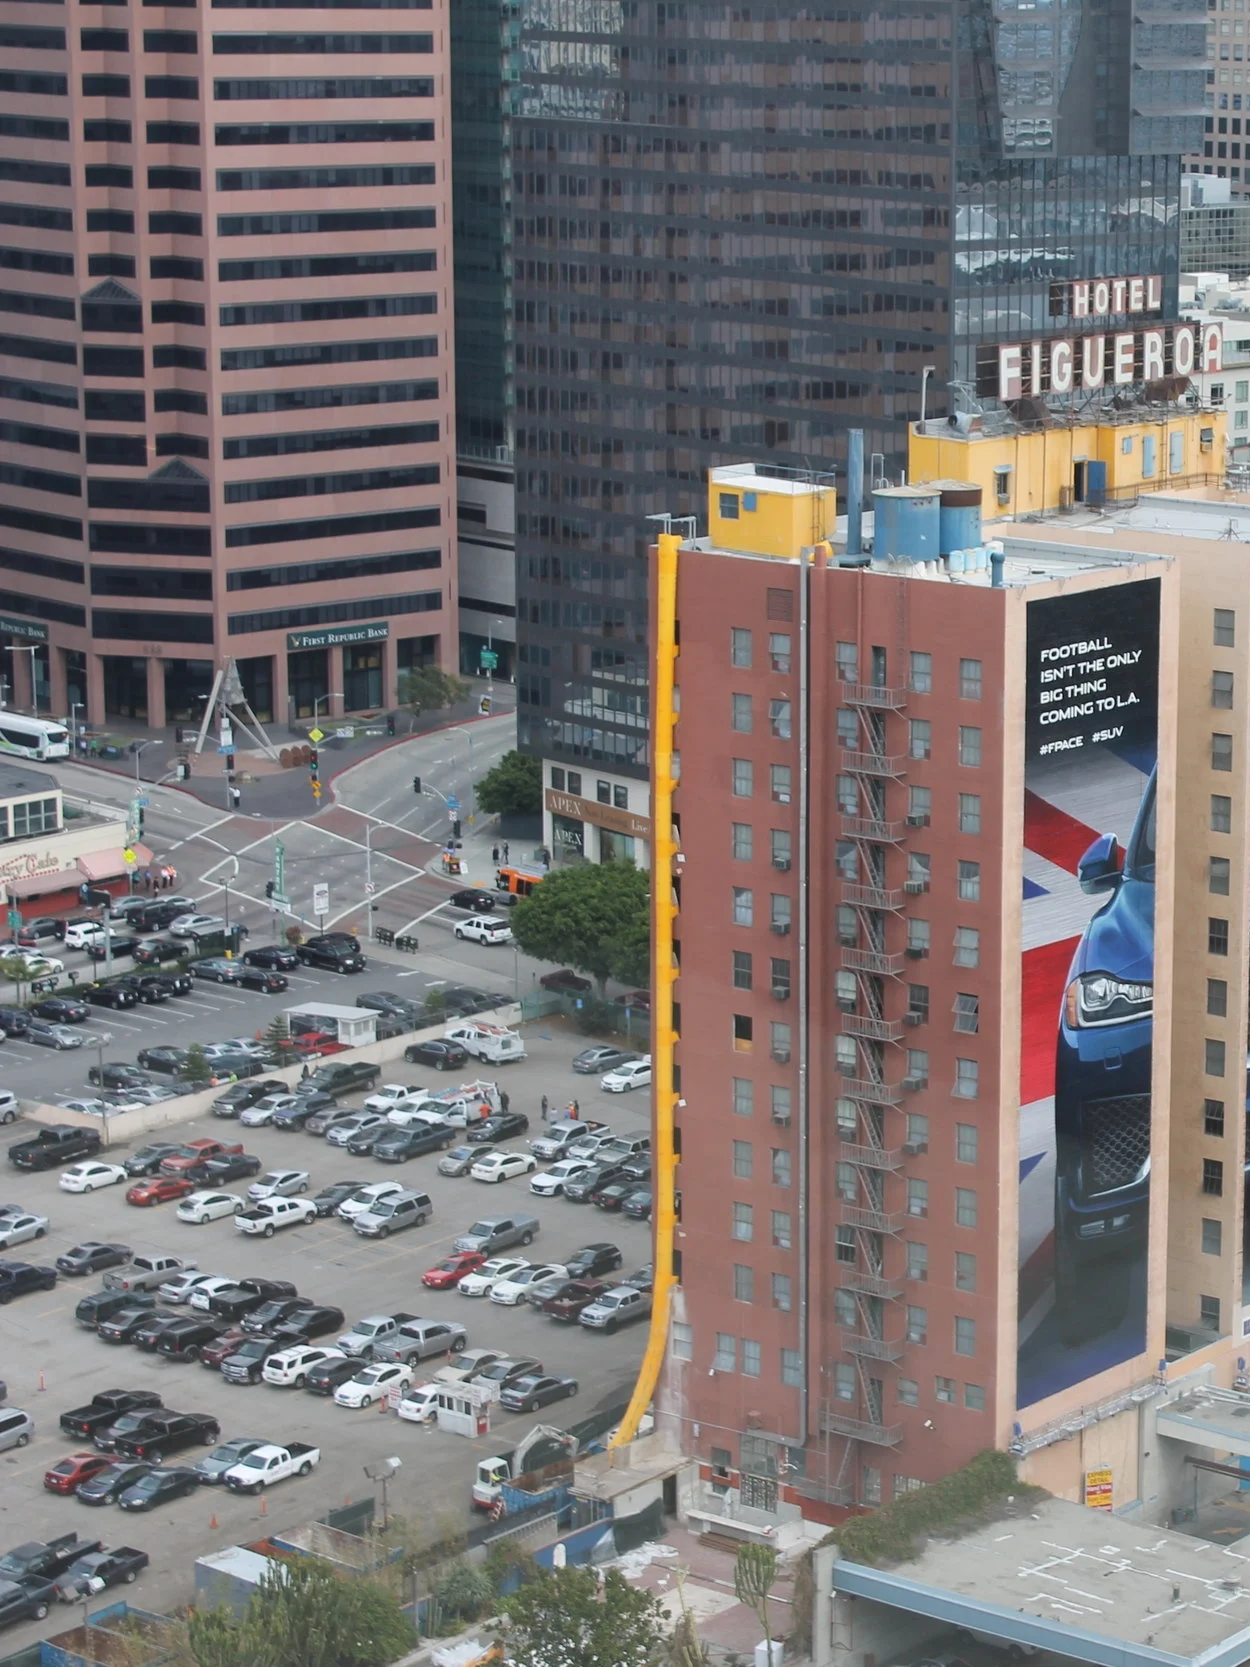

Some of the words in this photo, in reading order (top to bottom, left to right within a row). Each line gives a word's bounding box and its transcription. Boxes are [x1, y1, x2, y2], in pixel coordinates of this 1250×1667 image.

[1074, 277, 1161, 316] HOTEL
[999, 324, 1223, 399] FIGUEROA
[1041, 637, 1112, 662] FOOTBALL
[1040, 664, 1075, 683] ISN'T
[1077, 658, 1105, 675] THE
[1106, 650, 1142, 668] ONLY
[1040, 688, 1063, 704] BIG
[1065, 678, 1107, 698] THING
[1039, 701, 1094, 725] COMING
[1096, 697, 1115, 712] TO
[1117, 692, 1140, 708] L.A.
[1039, 735, 1084, 755] #FPACE
[1092, 725, 1124, 743] #SUV
[550, 795, 581, 817] APEX
[554, 828, 583, 846] APEX
